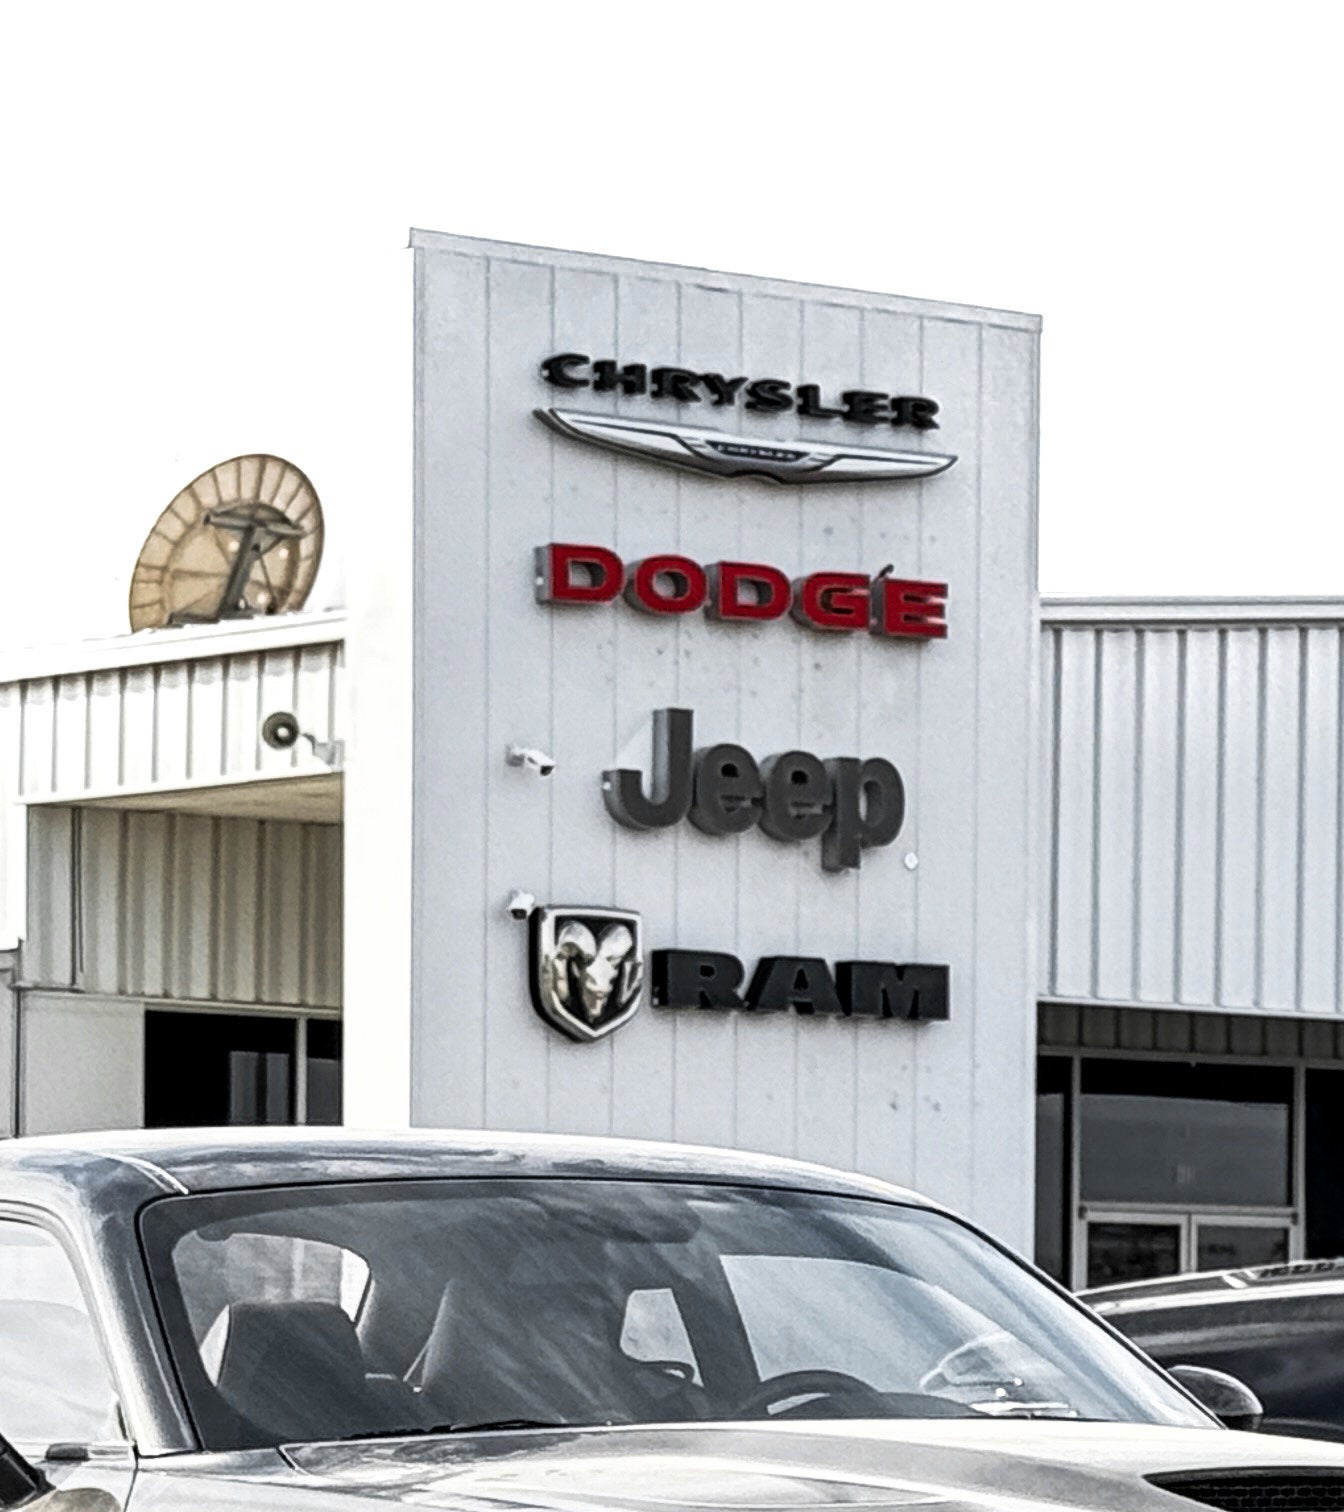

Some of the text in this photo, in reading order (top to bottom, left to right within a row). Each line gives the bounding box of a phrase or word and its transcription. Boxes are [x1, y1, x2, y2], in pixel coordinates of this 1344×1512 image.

[542, 352, 940, 429] CHRYSLER
[536, 542, 949, 639] DODGE
[602, 707, 906, 872] Jeep
[652, 949, 950, 1021] RAM
